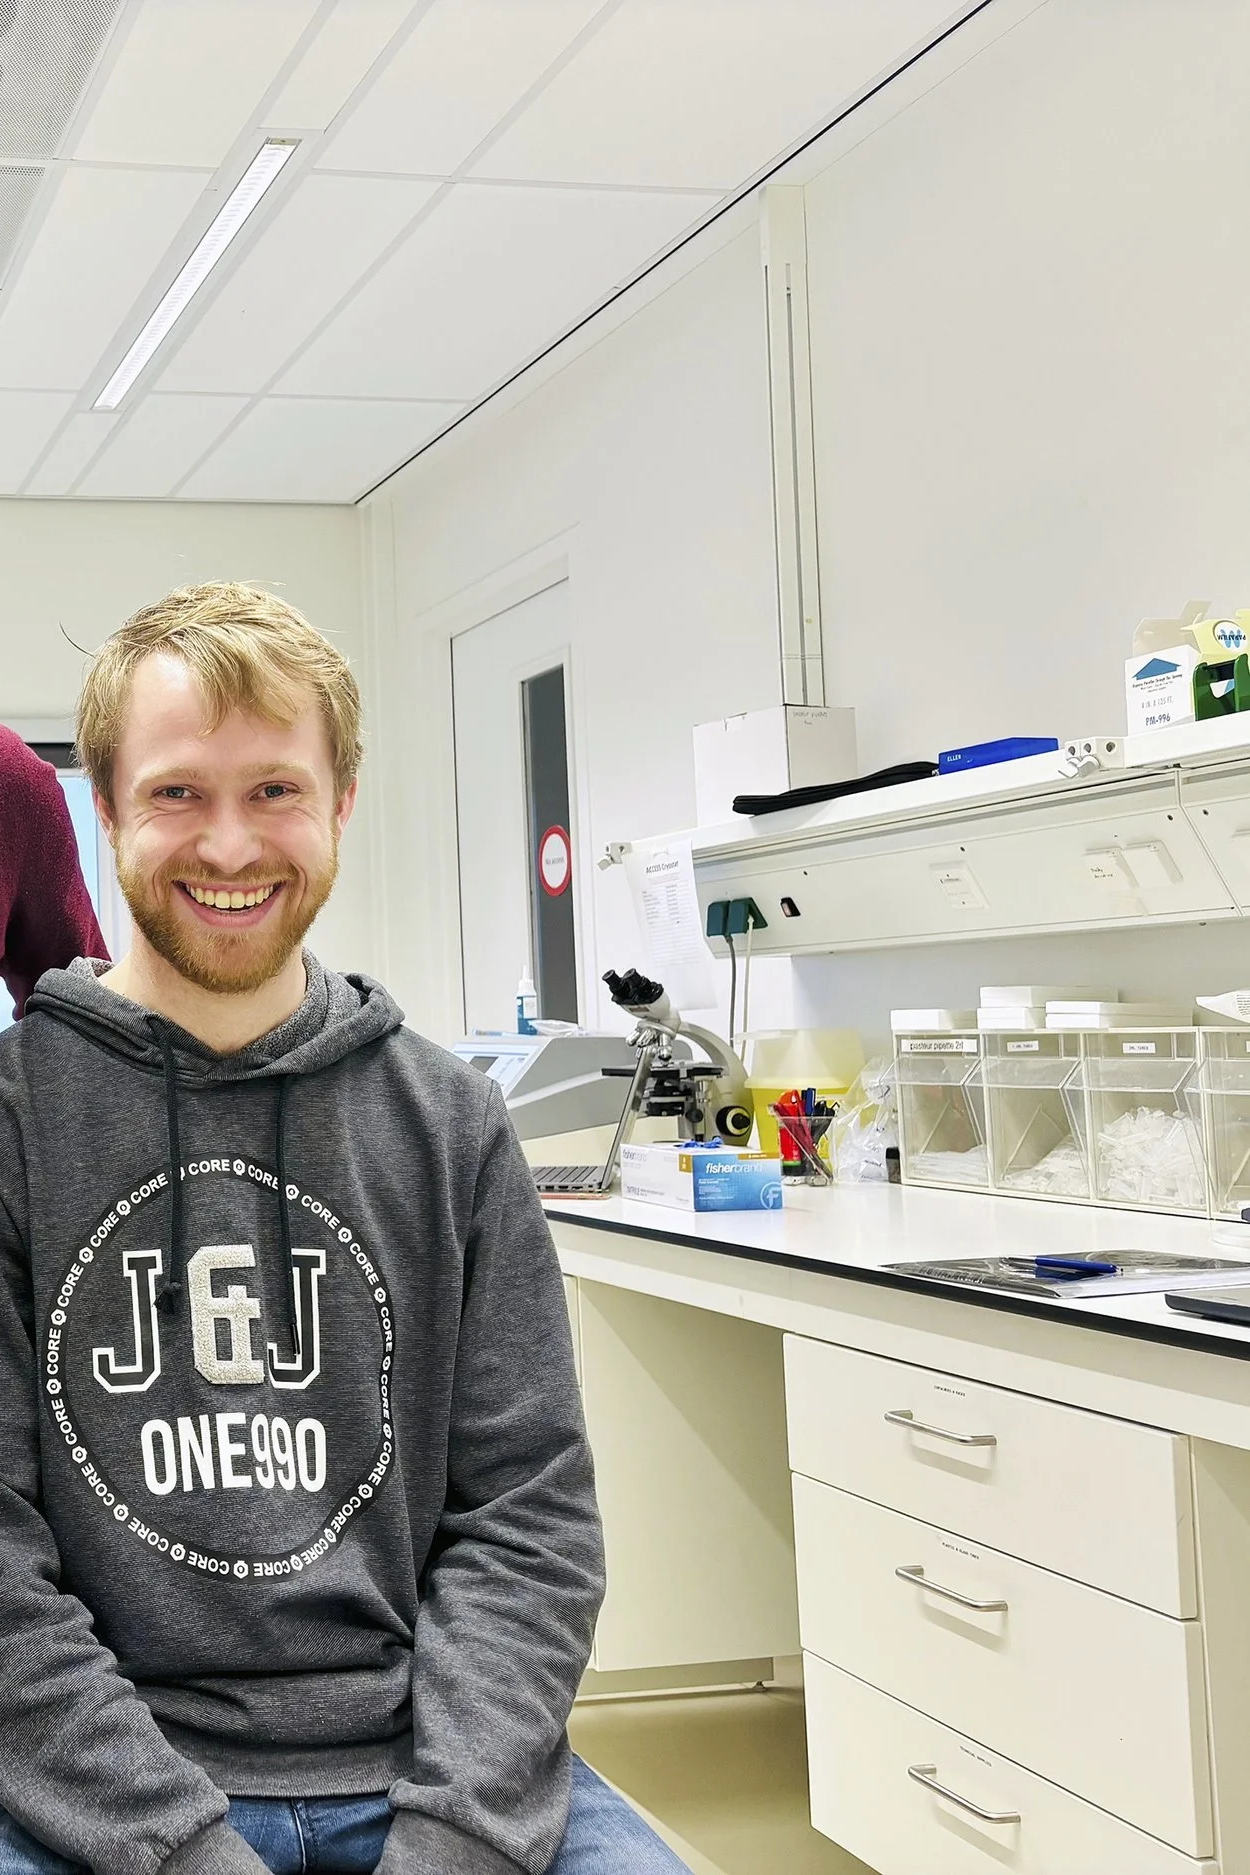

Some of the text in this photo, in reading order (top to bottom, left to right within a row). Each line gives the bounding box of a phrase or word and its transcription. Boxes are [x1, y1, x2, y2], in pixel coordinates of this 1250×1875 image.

[910, 1042, 933, 1051] pasteur
[933, 1042, 954, 1051] pipette
[189, 1159, 230, 1175] CORE
[705, 1162, 763, 1175] fisherbrand
[131, 1173, 168, 1204] CORE
[90, 1211, 121, 1247] CORE
[301, 1195, 341, 1231] CORE
[350, 1243, 379, 1286] CORE
[58, 1263, 84, 1307] CORE
[381, 1307, 392, 1352] CORE
[47, 1328, 61, 1374] CORE
[380, 1374, 392, 1419] CORE
[51, 1399, 77, 1445] CORE
[368, 1441, 394, 1488] CORE
[81, 1463, 116, 1506] CORE
[330, 1495, 363, 1535] CORE
[128, 1517, 169, 1552] CORE
[302, 1537, 331, 1566] CORE
[188, 1551, 229, 1575] CORE
[253, 1562, 292, 1576] CORE
